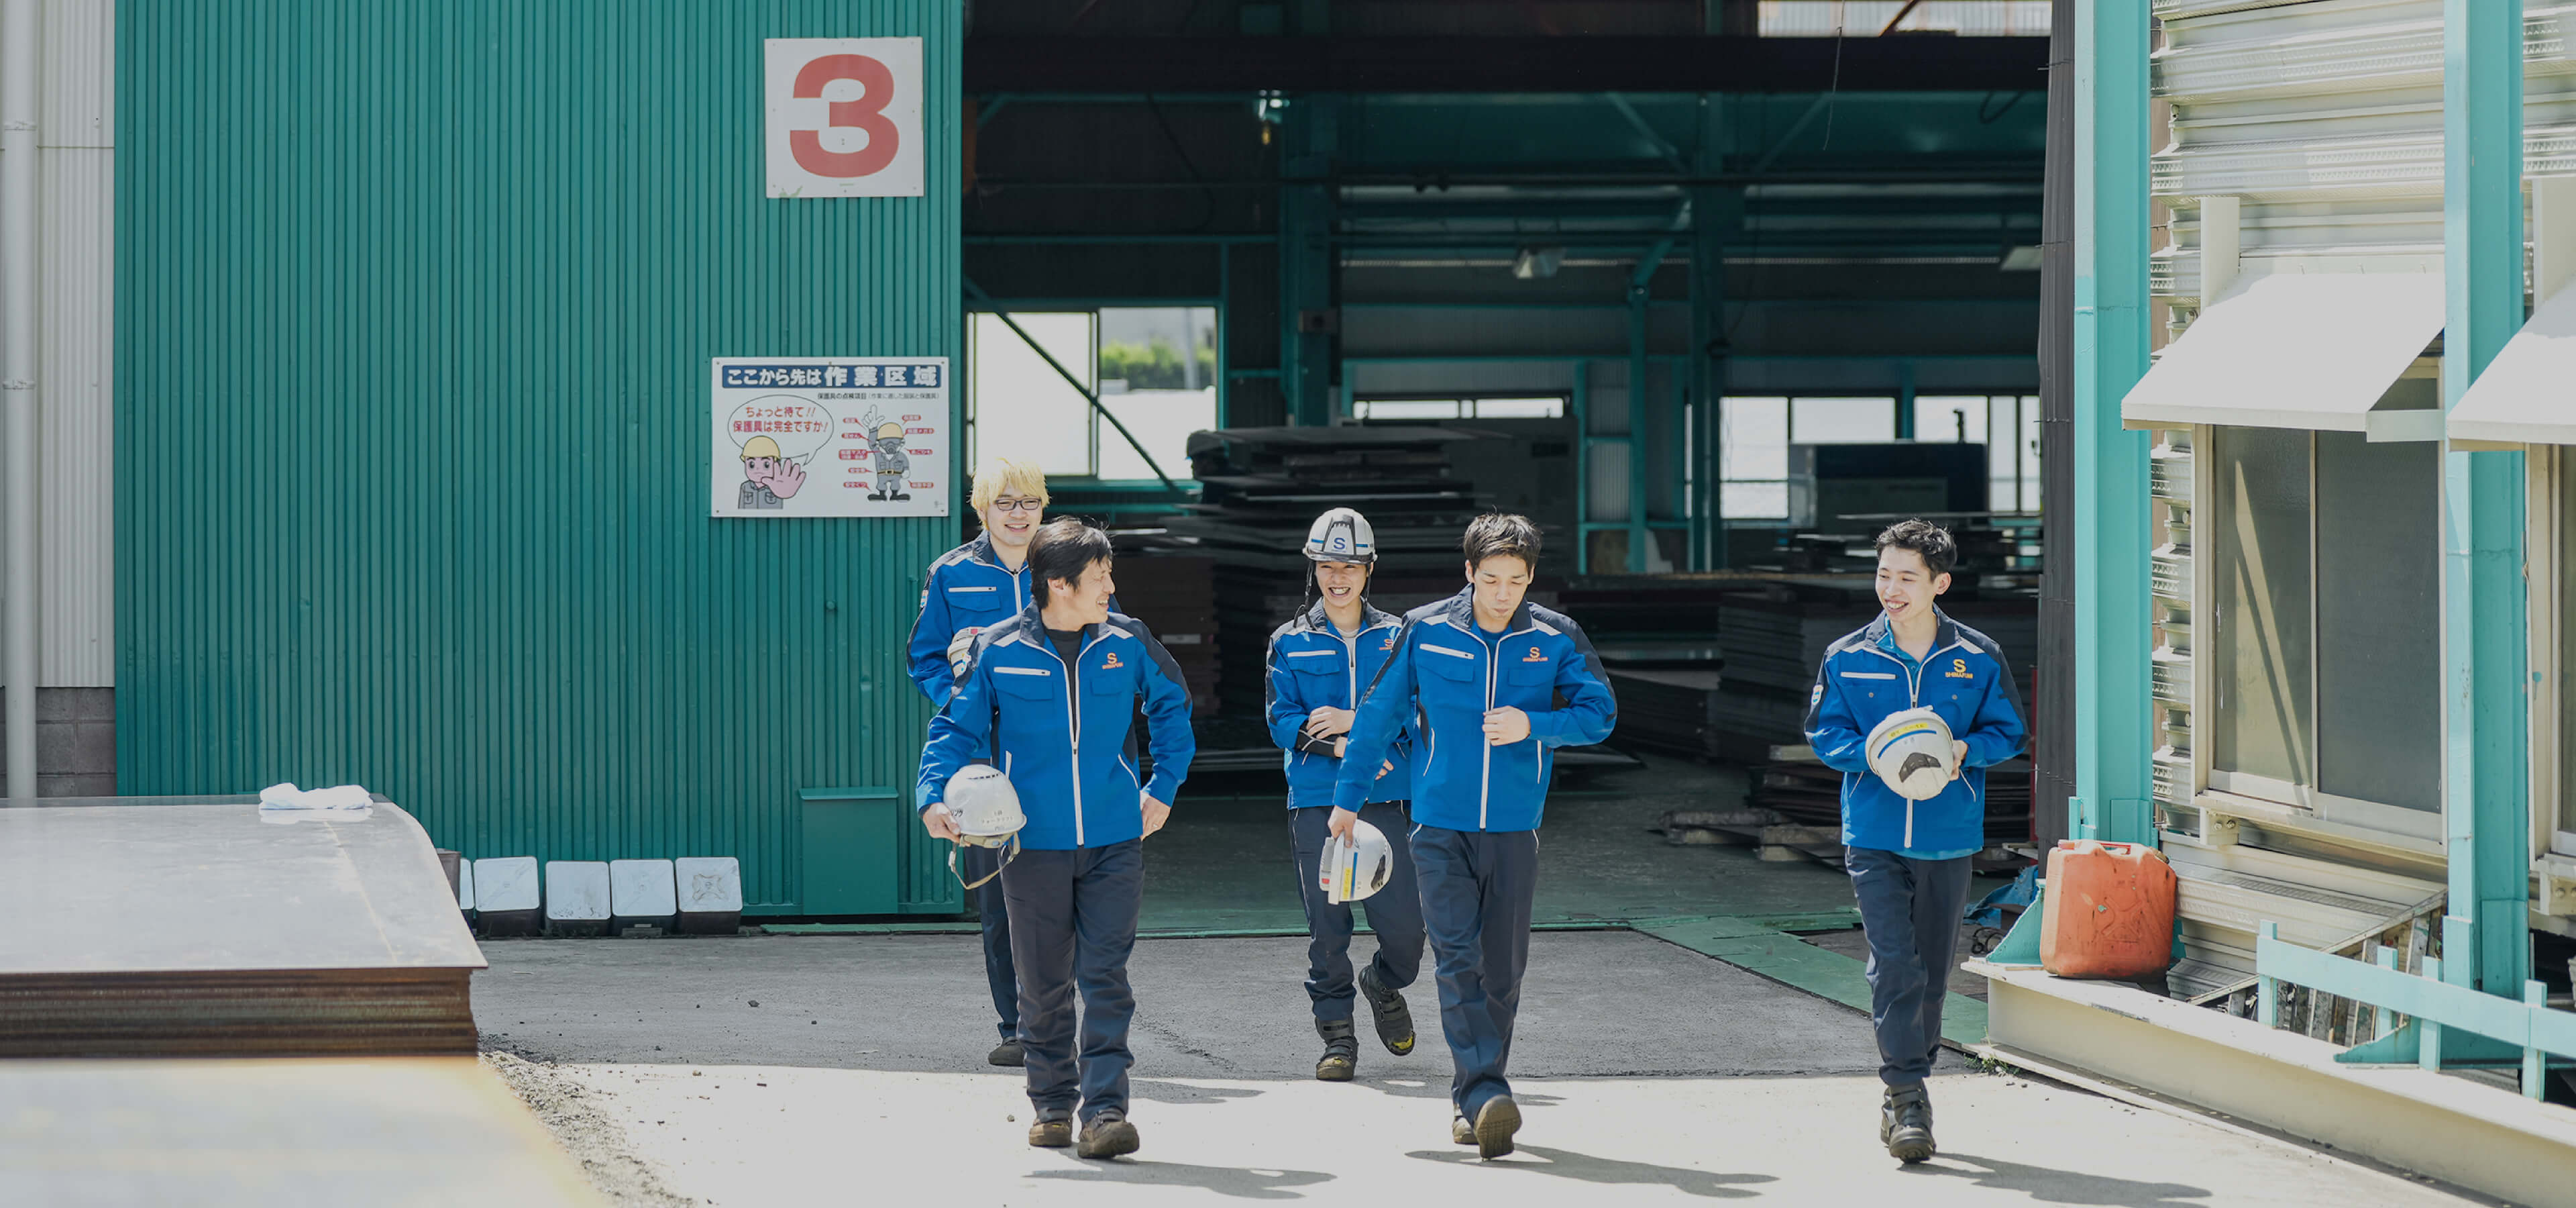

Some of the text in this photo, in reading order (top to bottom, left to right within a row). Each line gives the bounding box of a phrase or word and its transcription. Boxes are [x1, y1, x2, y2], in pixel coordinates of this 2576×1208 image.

[790, 54, 900, 178] 3
[727, 366, 938, 387] ここから先は作業区域
[1333, 538, 1346, 550] S
[1107, 652, 1117, 664] S
[1529, 646, 1540, 658] S
[1953, 658, 1966, 672] S
